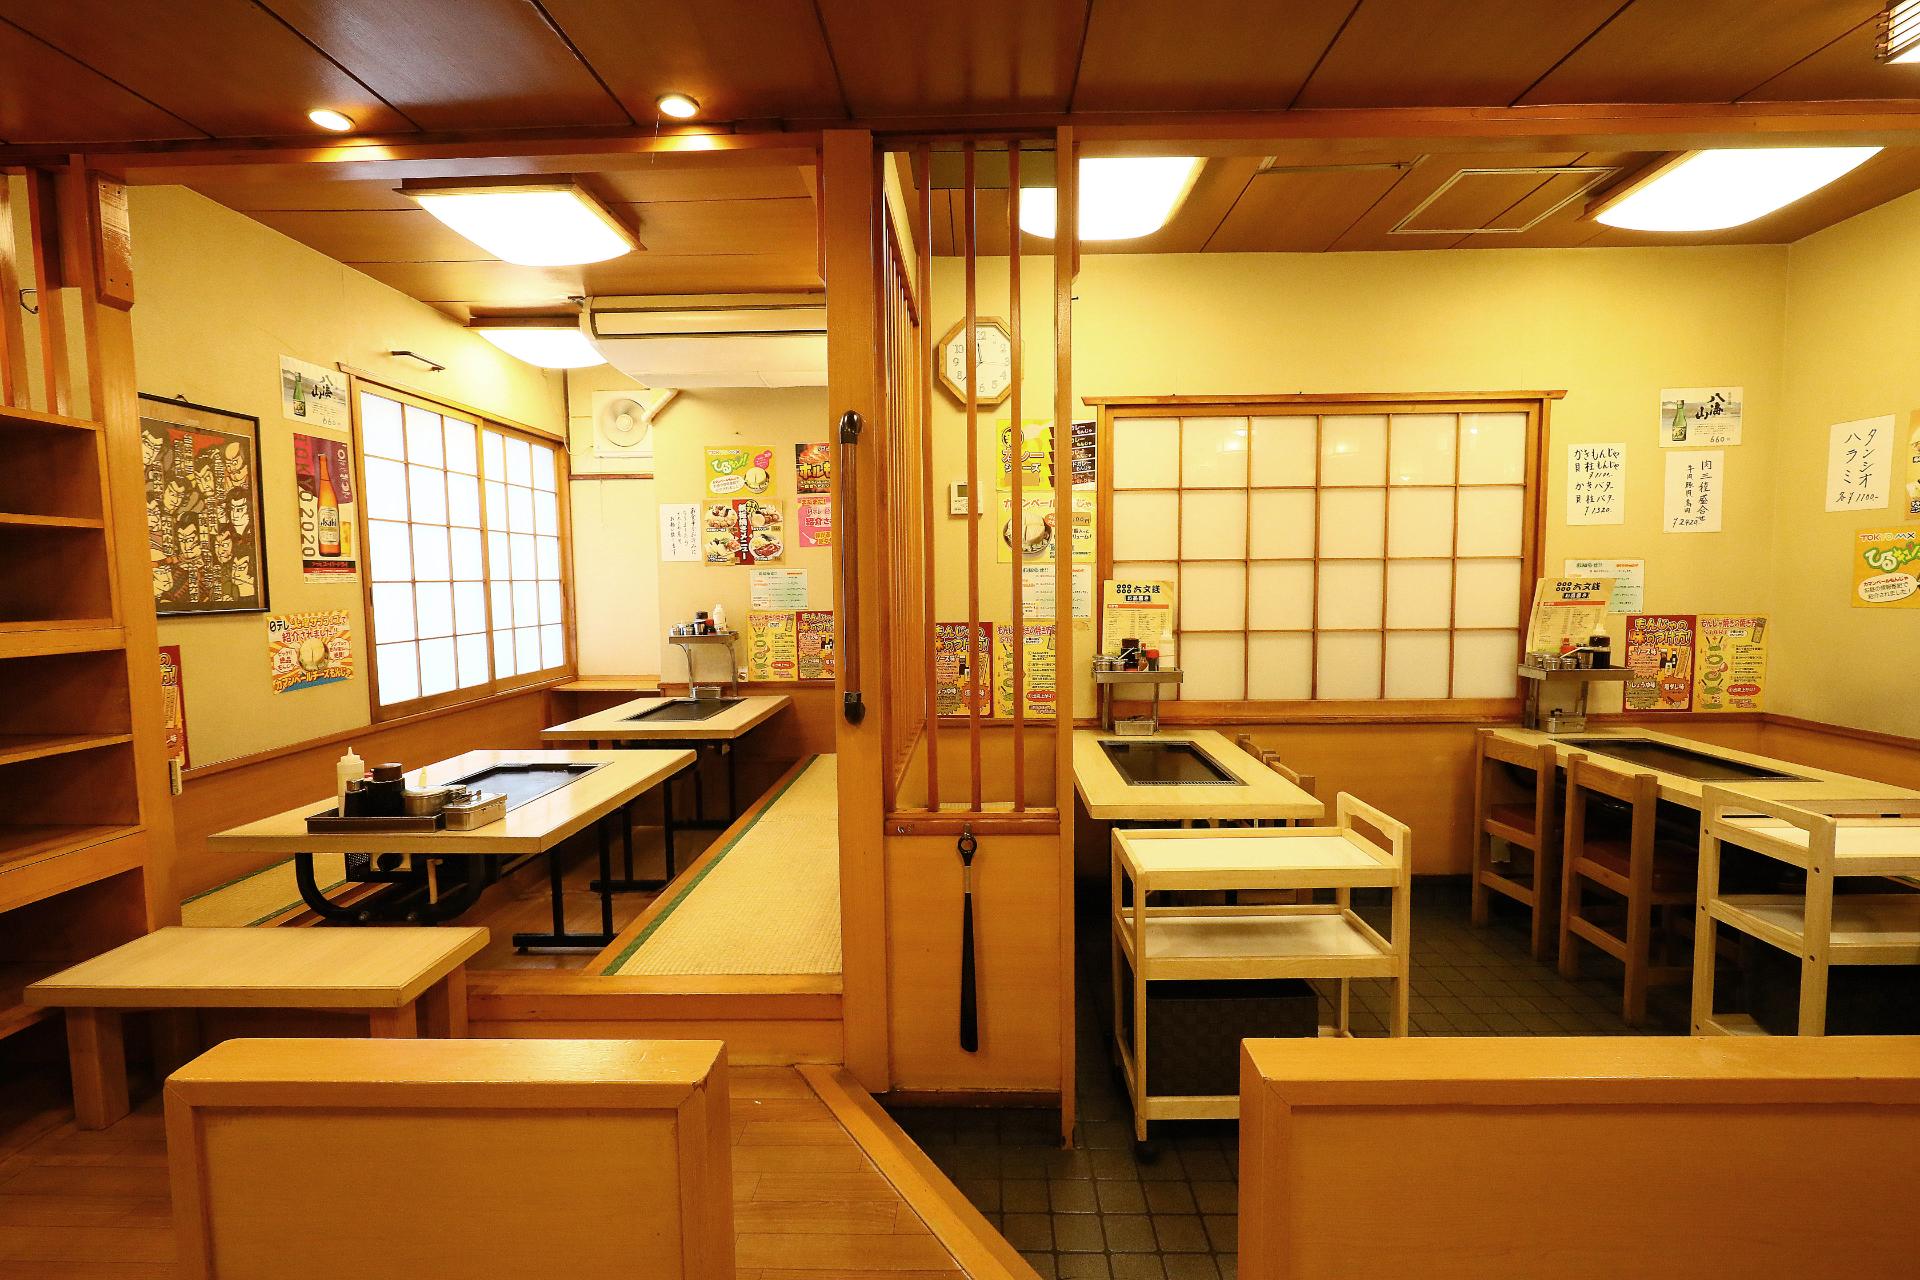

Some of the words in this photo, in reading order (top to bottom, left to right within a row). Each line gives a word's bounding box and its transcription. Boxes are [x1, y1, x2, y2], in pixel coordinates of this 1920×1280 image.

[1695, 393, 1725, 420] 八海山
[1843, 433, 1862, 484] ハラミ
[1859, 429, 1877, 488] タンシオ
[300, 508, 316, 557] 2020
[1629, 630, 1692, 646] 味のつけ方!
[1635, 618, 1688, 630] もんじゃの
